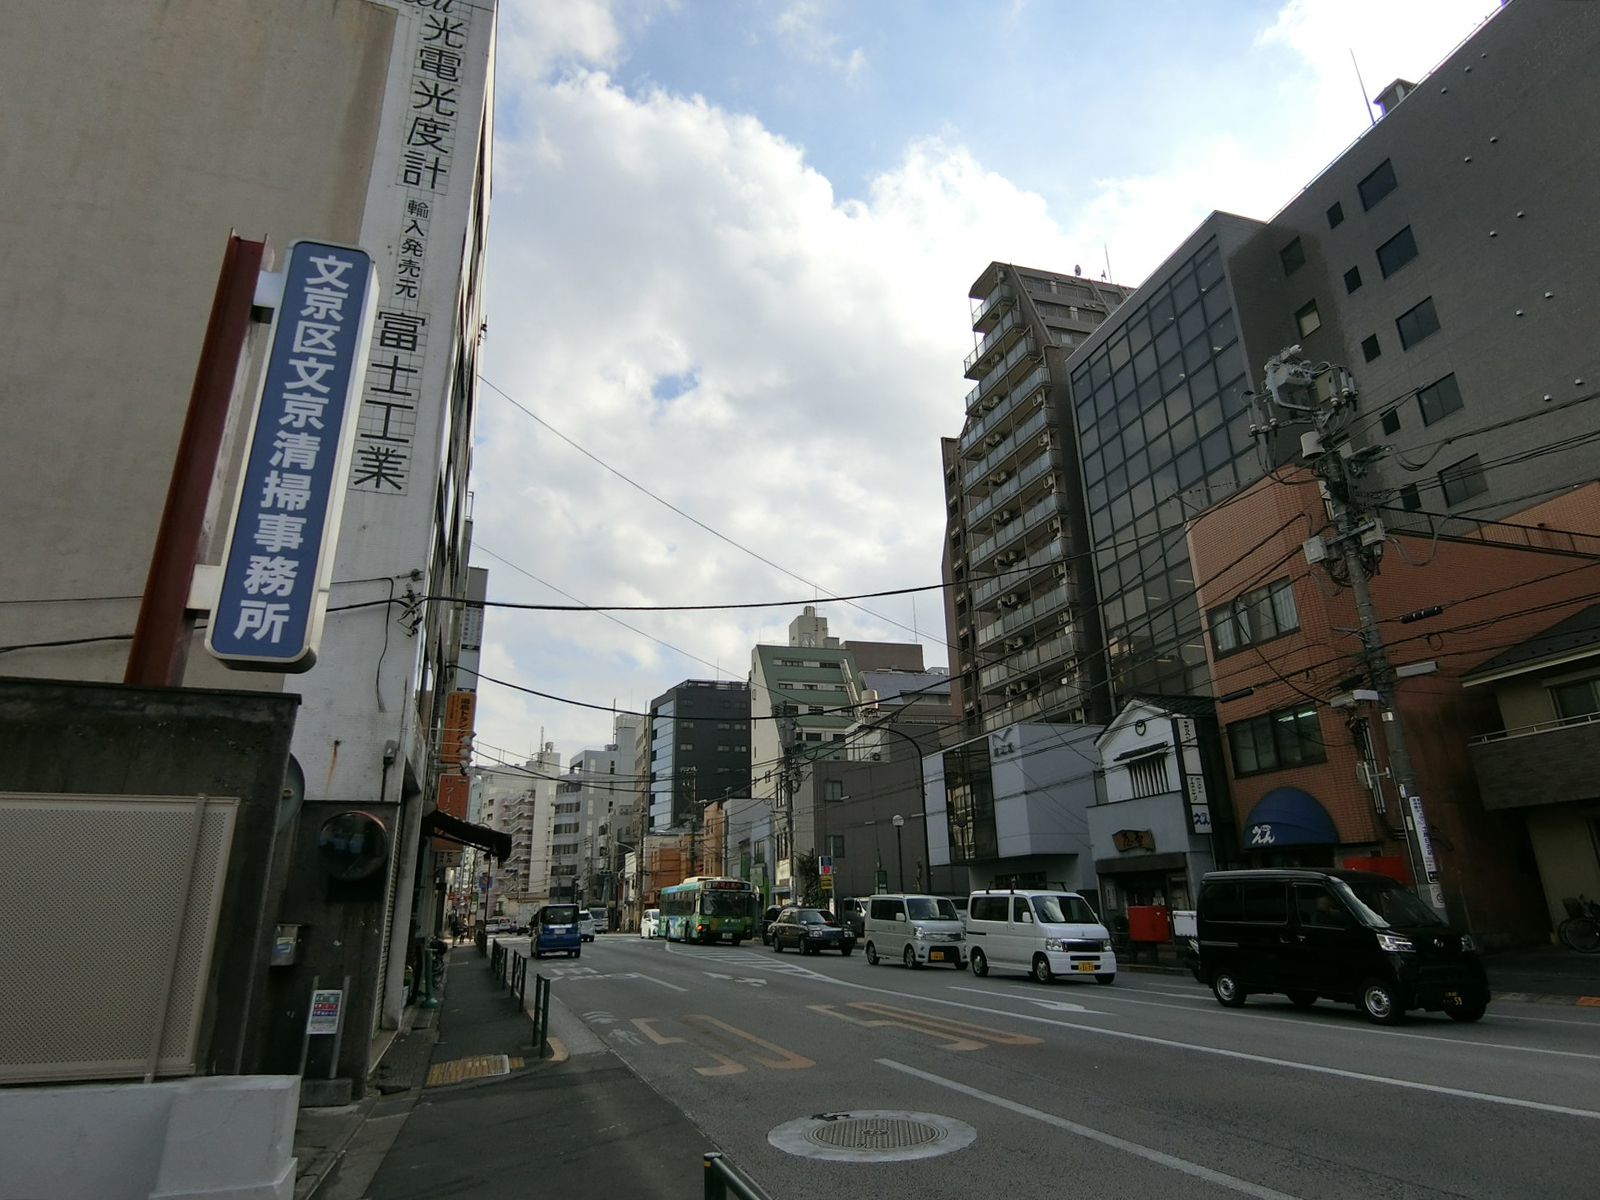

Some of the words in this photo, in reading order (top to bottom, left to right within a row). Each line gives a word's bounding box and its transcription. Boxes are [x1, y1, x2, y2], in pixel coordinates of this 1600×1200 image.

[403, 14, 465, 190] 光電光度計
[395, 199, 430, 298] 輸入発売元
[233, 254, 354, 644] 文京区文京清掃事務所
[353, 311, 426, 490] 富士工業
[806, 1001, 1046, 1051] 50
